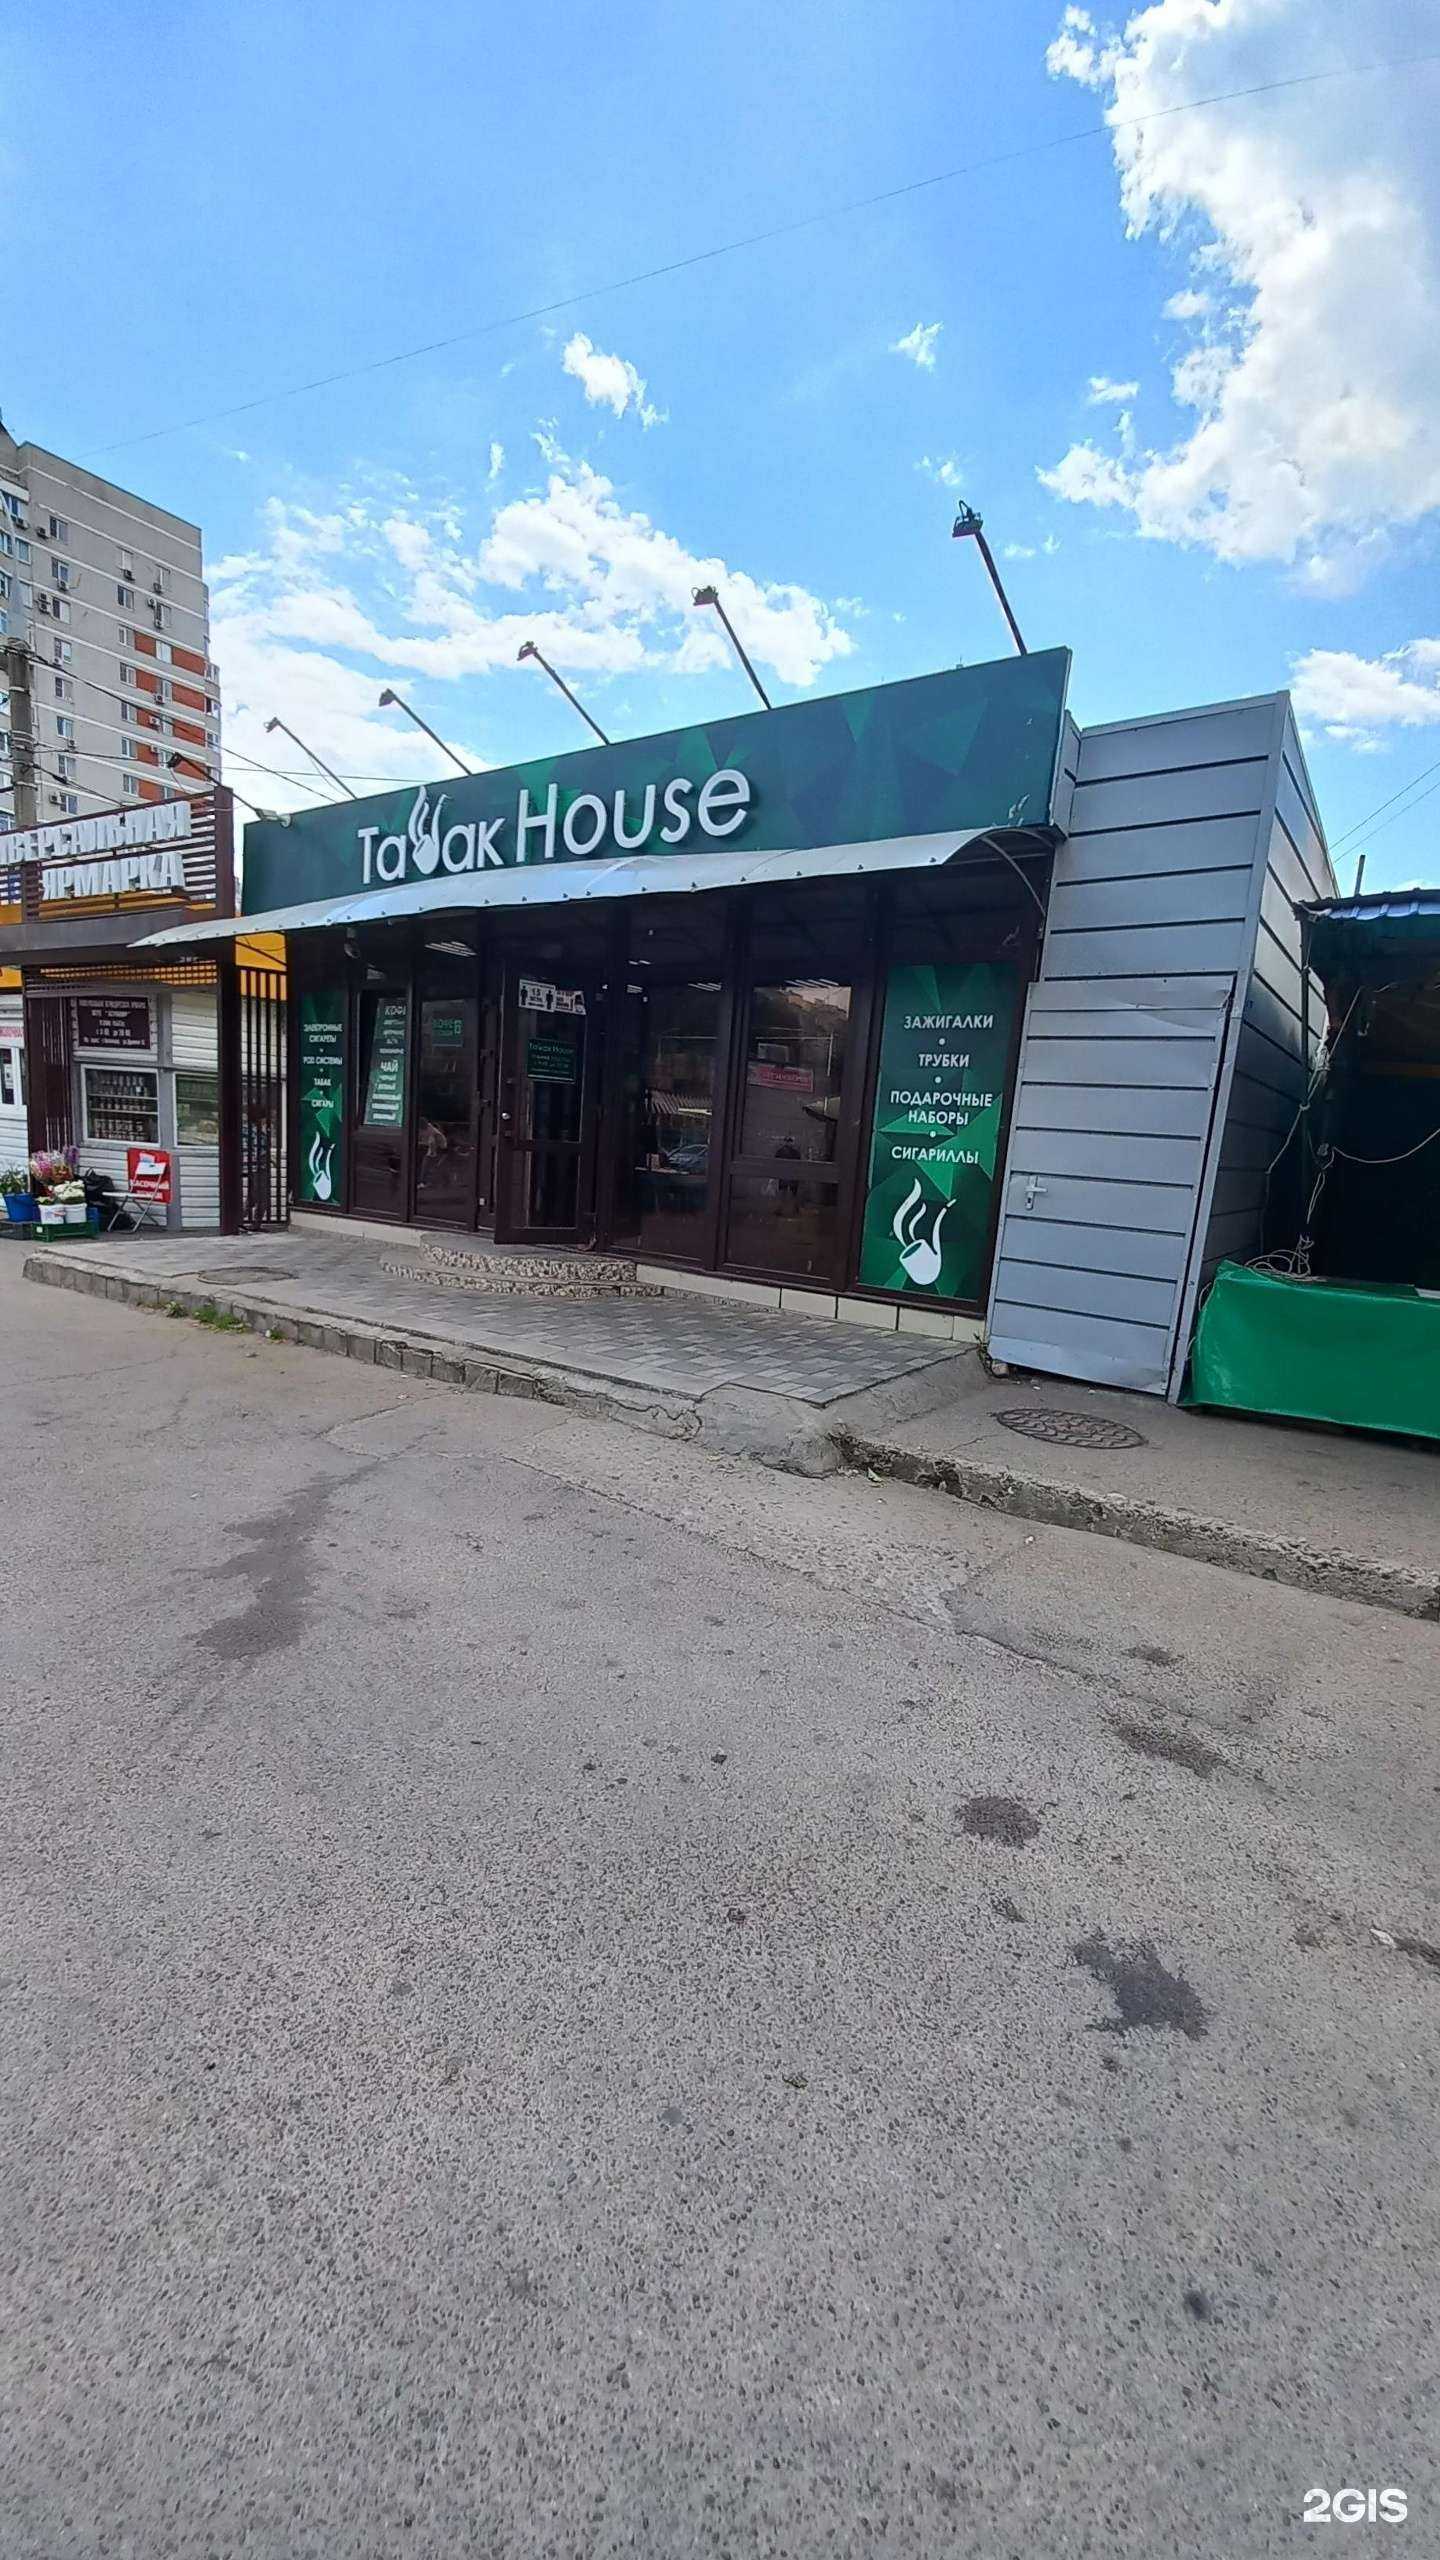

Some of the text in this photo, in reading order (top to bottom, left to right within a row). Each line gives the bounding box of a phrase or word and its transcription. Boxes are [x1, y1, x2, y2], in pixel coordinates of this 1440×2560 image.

[516, 769, 751, 863] House
[39, 852, 187, 900] ЯРМАРКА
[904, 1015, 994, 1029] ЗАЖИГАЛКИ
[380, 1059, 399, 1073] ЧАЙ
[919, 1054, 969, 1068] ТРУБКИ
[890, 1090, 993, 1107] ПОДАРОЧНЫЕ
[908, 1111, 969, 1126] НАБОРЫ
[891, 1146, 979, 1164] СИГАРИЛЛЫ
